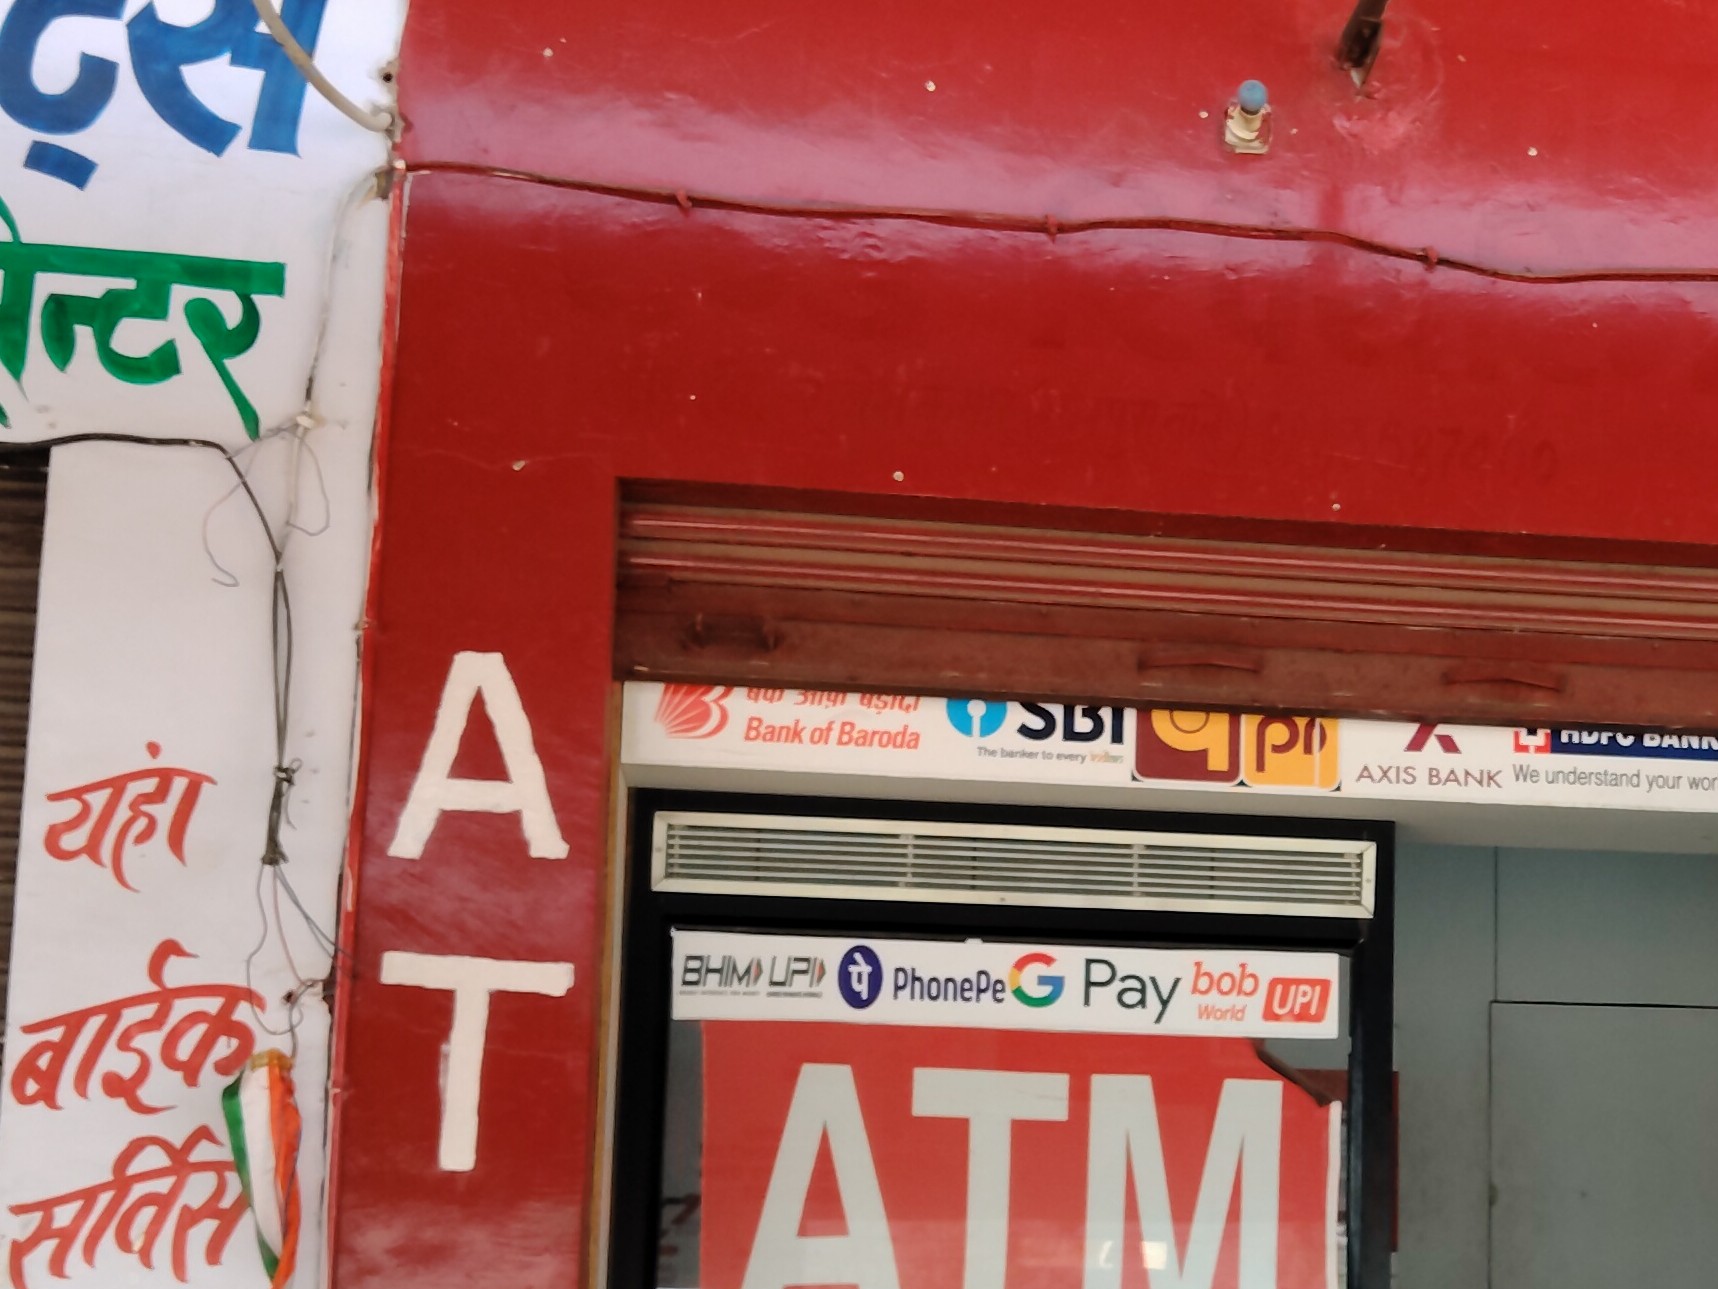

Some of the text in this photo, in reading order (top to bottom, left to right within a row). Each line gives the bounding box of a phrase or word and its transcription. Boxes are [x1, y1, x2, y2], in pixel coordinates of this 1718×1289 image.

[744, 715, 921, 750] Bank of Baroda
[1017, 701, 1124, 744] SBI
[1356, 764, 1503, 789] AXIS BANK
[1512, 764, 1541, 784] We
[1545, 766, 1640, 788] understand
[1645, 771, 1683, 793] your
[44, 741, 218, 892] यहां
[681, 955, 818, 988] BHIM UPI
[894, 967, 1006, 1003] PhonePe
[1191, 961, 1259, 997] bob
[1084, 958, 1182, 1024] Pay
[1272, 983, 1321, 1016] UPI
[10, 938, 267, 1116] बाईक
[1198, 1004, 1247, 1022] World
